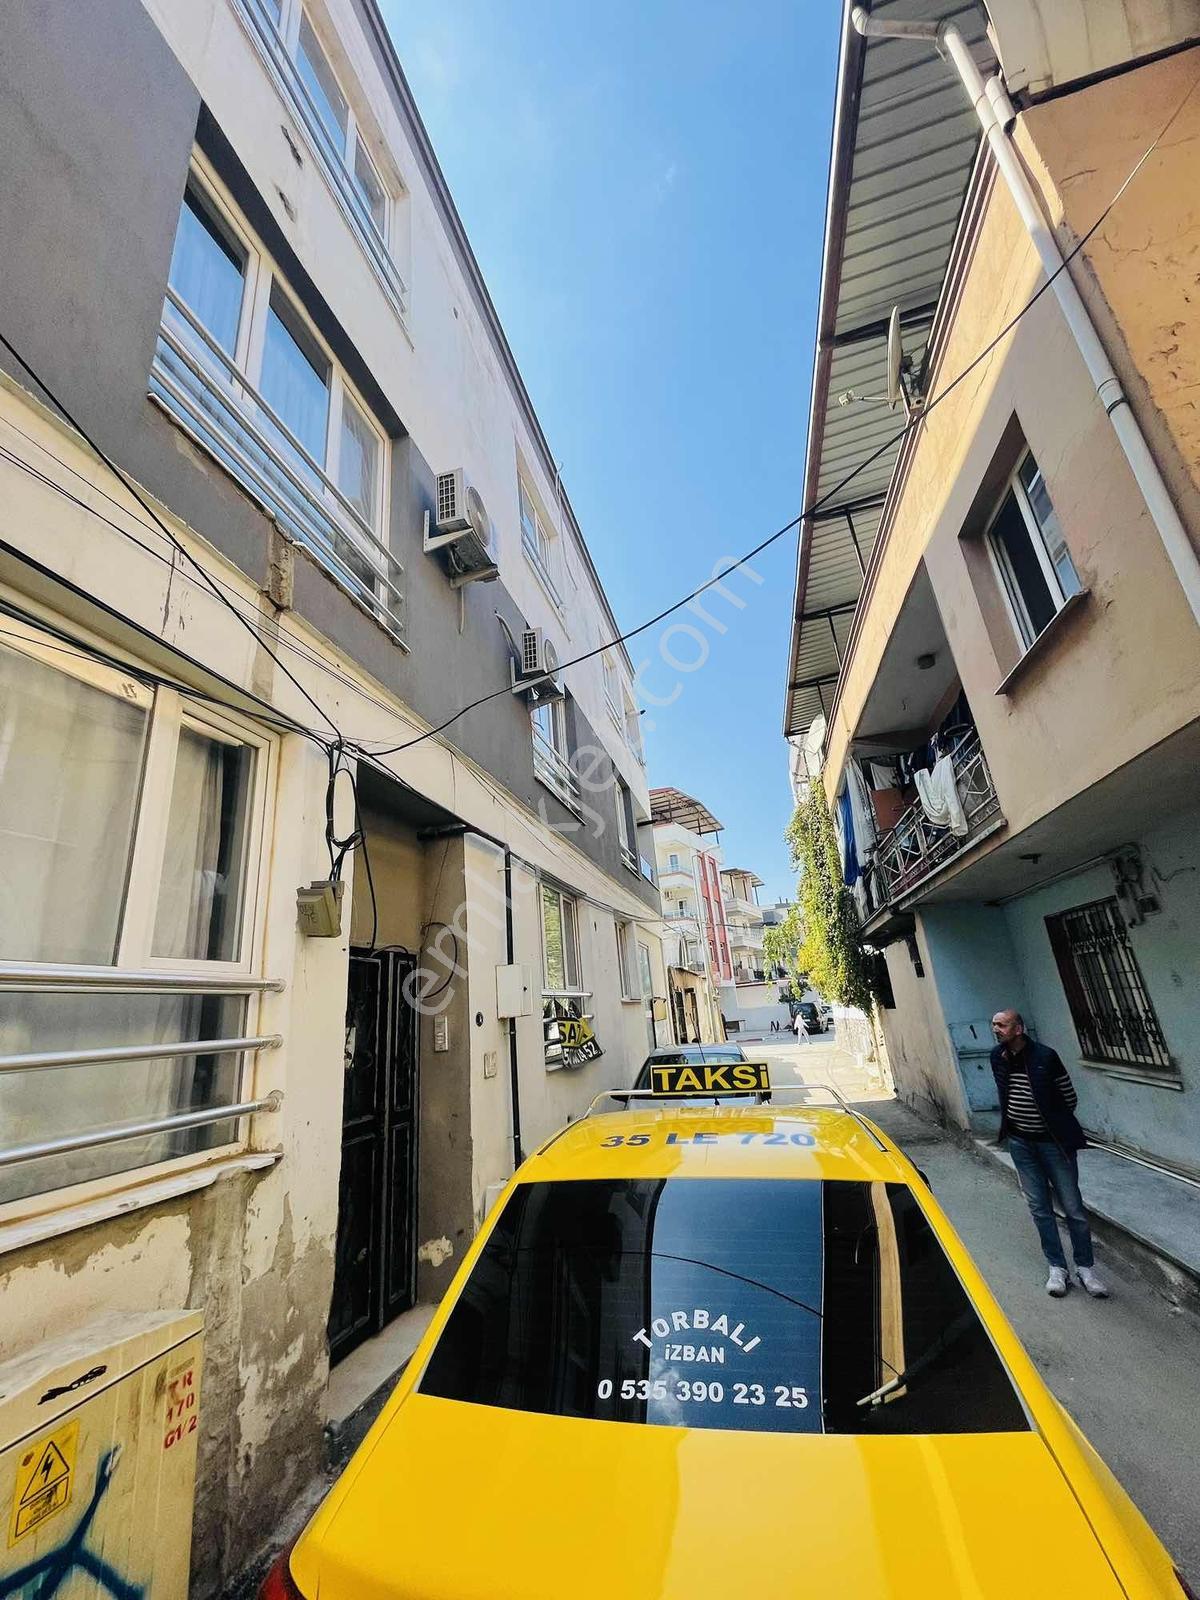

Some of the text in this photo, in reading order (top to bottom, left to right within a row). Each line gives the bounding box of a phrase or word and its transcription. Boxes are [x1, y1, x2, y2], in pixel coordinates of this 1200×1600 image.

[600, 1132, 817, 1147] 35 LE 720
[632, 1309, 762, 1353] TORBALI
[597, 1379, 809, 1408] 0 535 390 23 25
